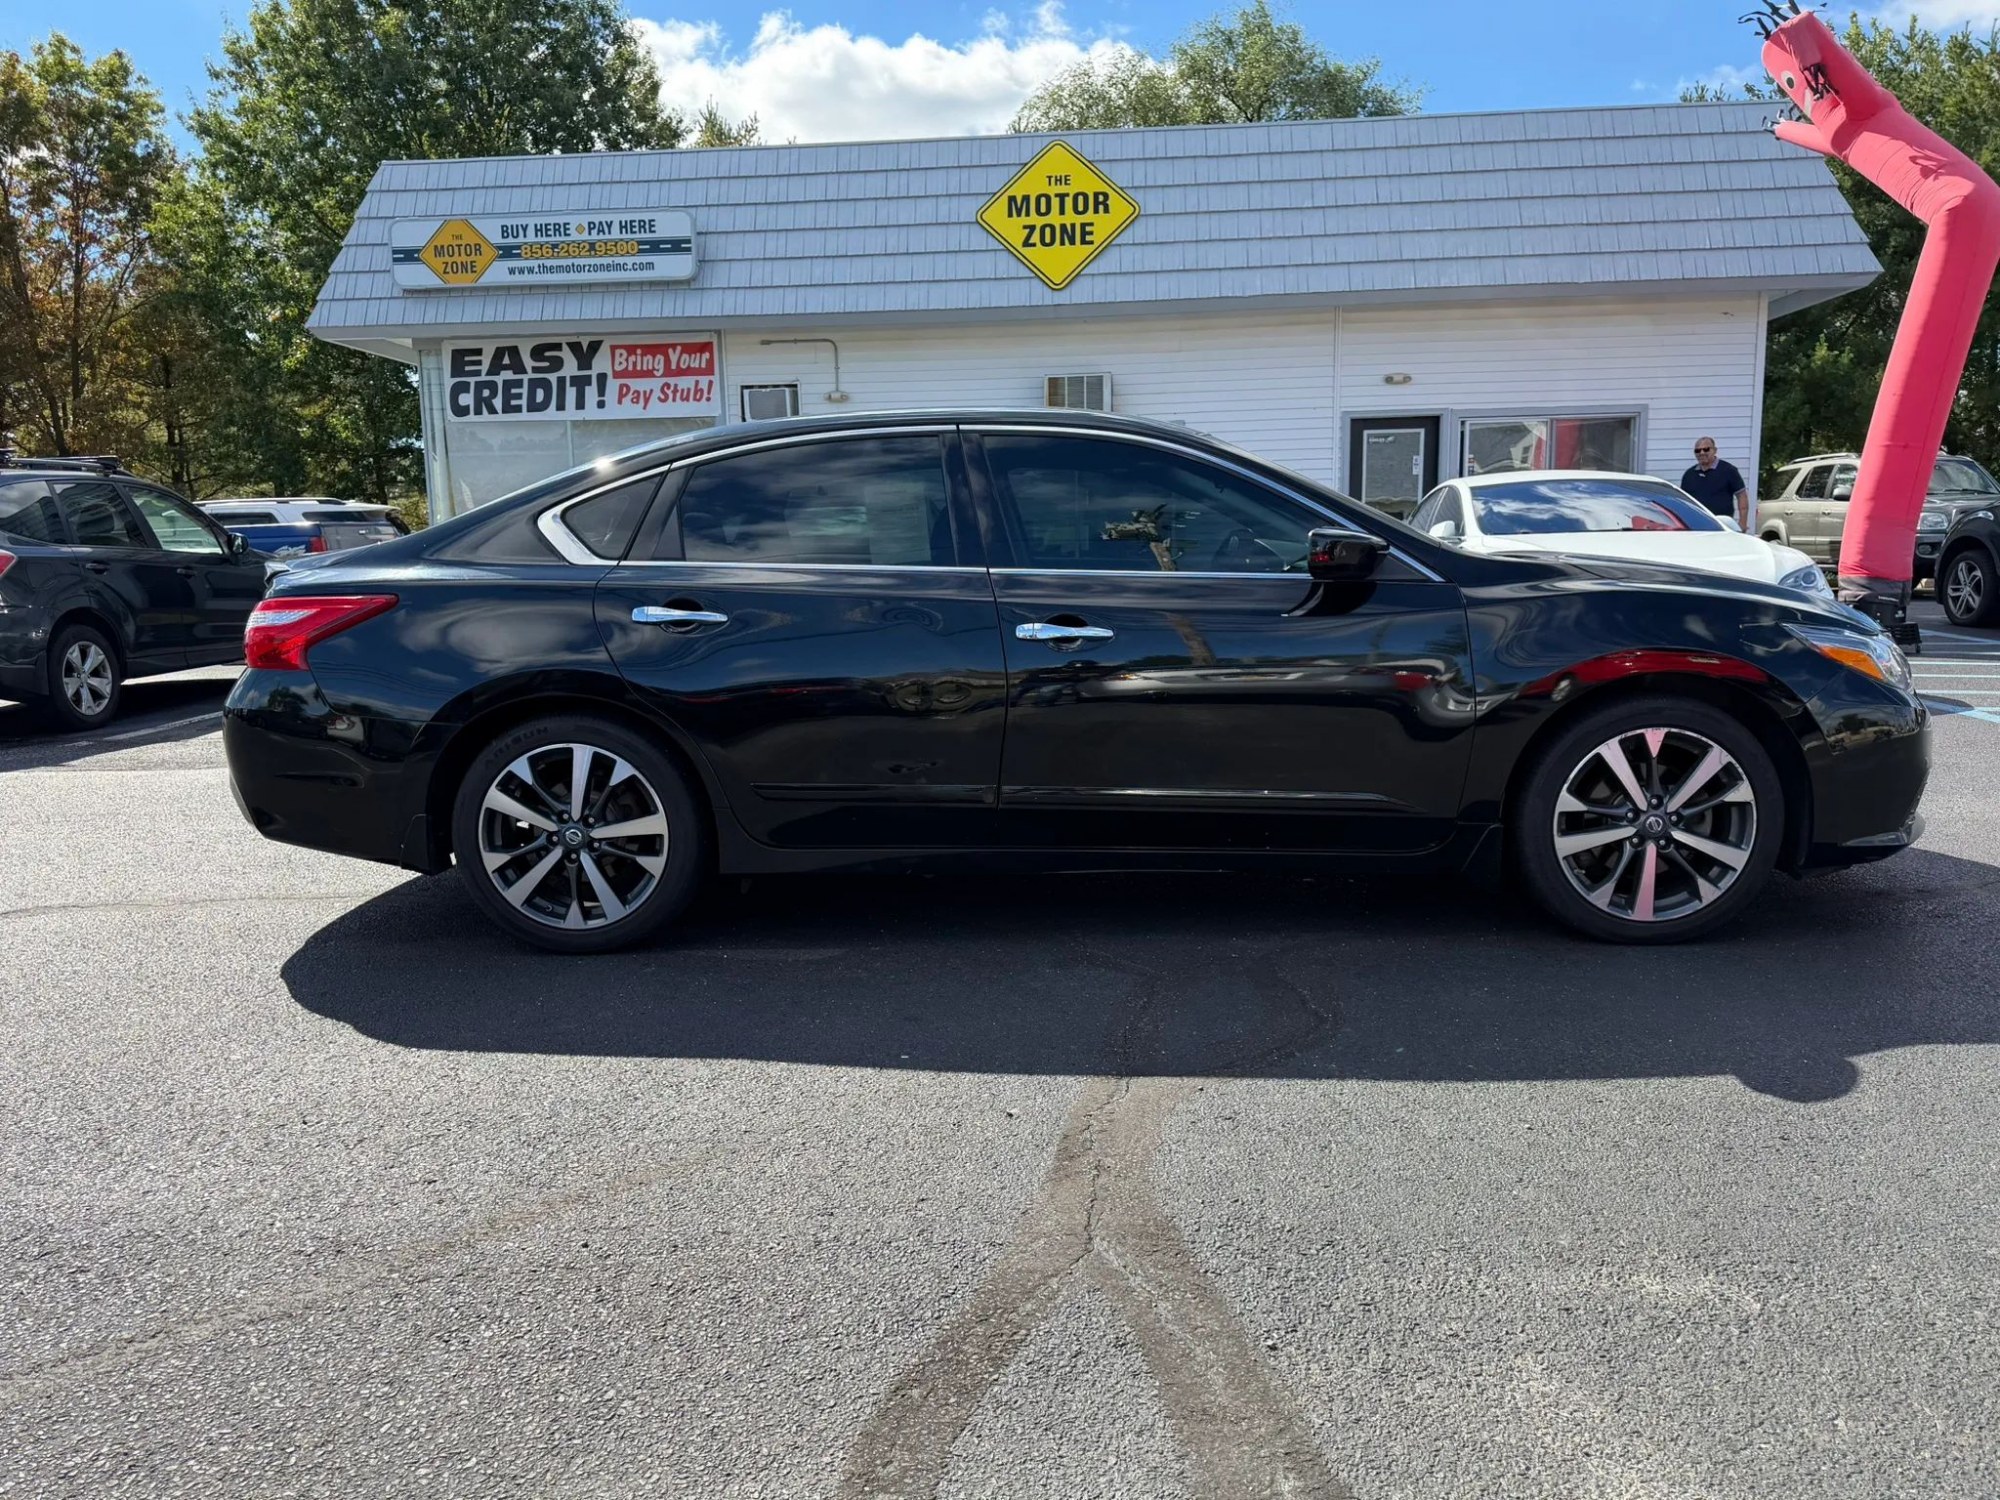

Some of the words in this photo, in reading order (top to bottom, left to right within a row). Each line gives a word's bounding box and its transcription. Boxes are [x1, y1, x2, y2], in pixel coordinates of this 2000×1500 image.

[1046, 174, 1071, 186] THE
[1007, 191, 1110, 218] MOTOR
[451, 233, 463, 241] THE
[501, 223, 529, 239] BUY
[534, 222, 571, 238] HERE
[587, 220, 614, 236] PAY
[619, 219, 657, 235] HERE
[1021, 222, 1095, 248] ZONE
[433, 243, 483, 258] MOTOR
[520, 240, 639, 259] 856.262.9500
[442, 260, 478, 275] ZONE
[507, 260, 655, 276] www.themotorzoneinc.com
[450, 339, 605, 378] EASY
[613, 348, 665, 377] Bring
[667, 345, 710, 370] Your
[449, 372, 608, 418] CREDIT!
[617, 382, 654, 411] Pay
[657, 379, 714, 403] Stub!
